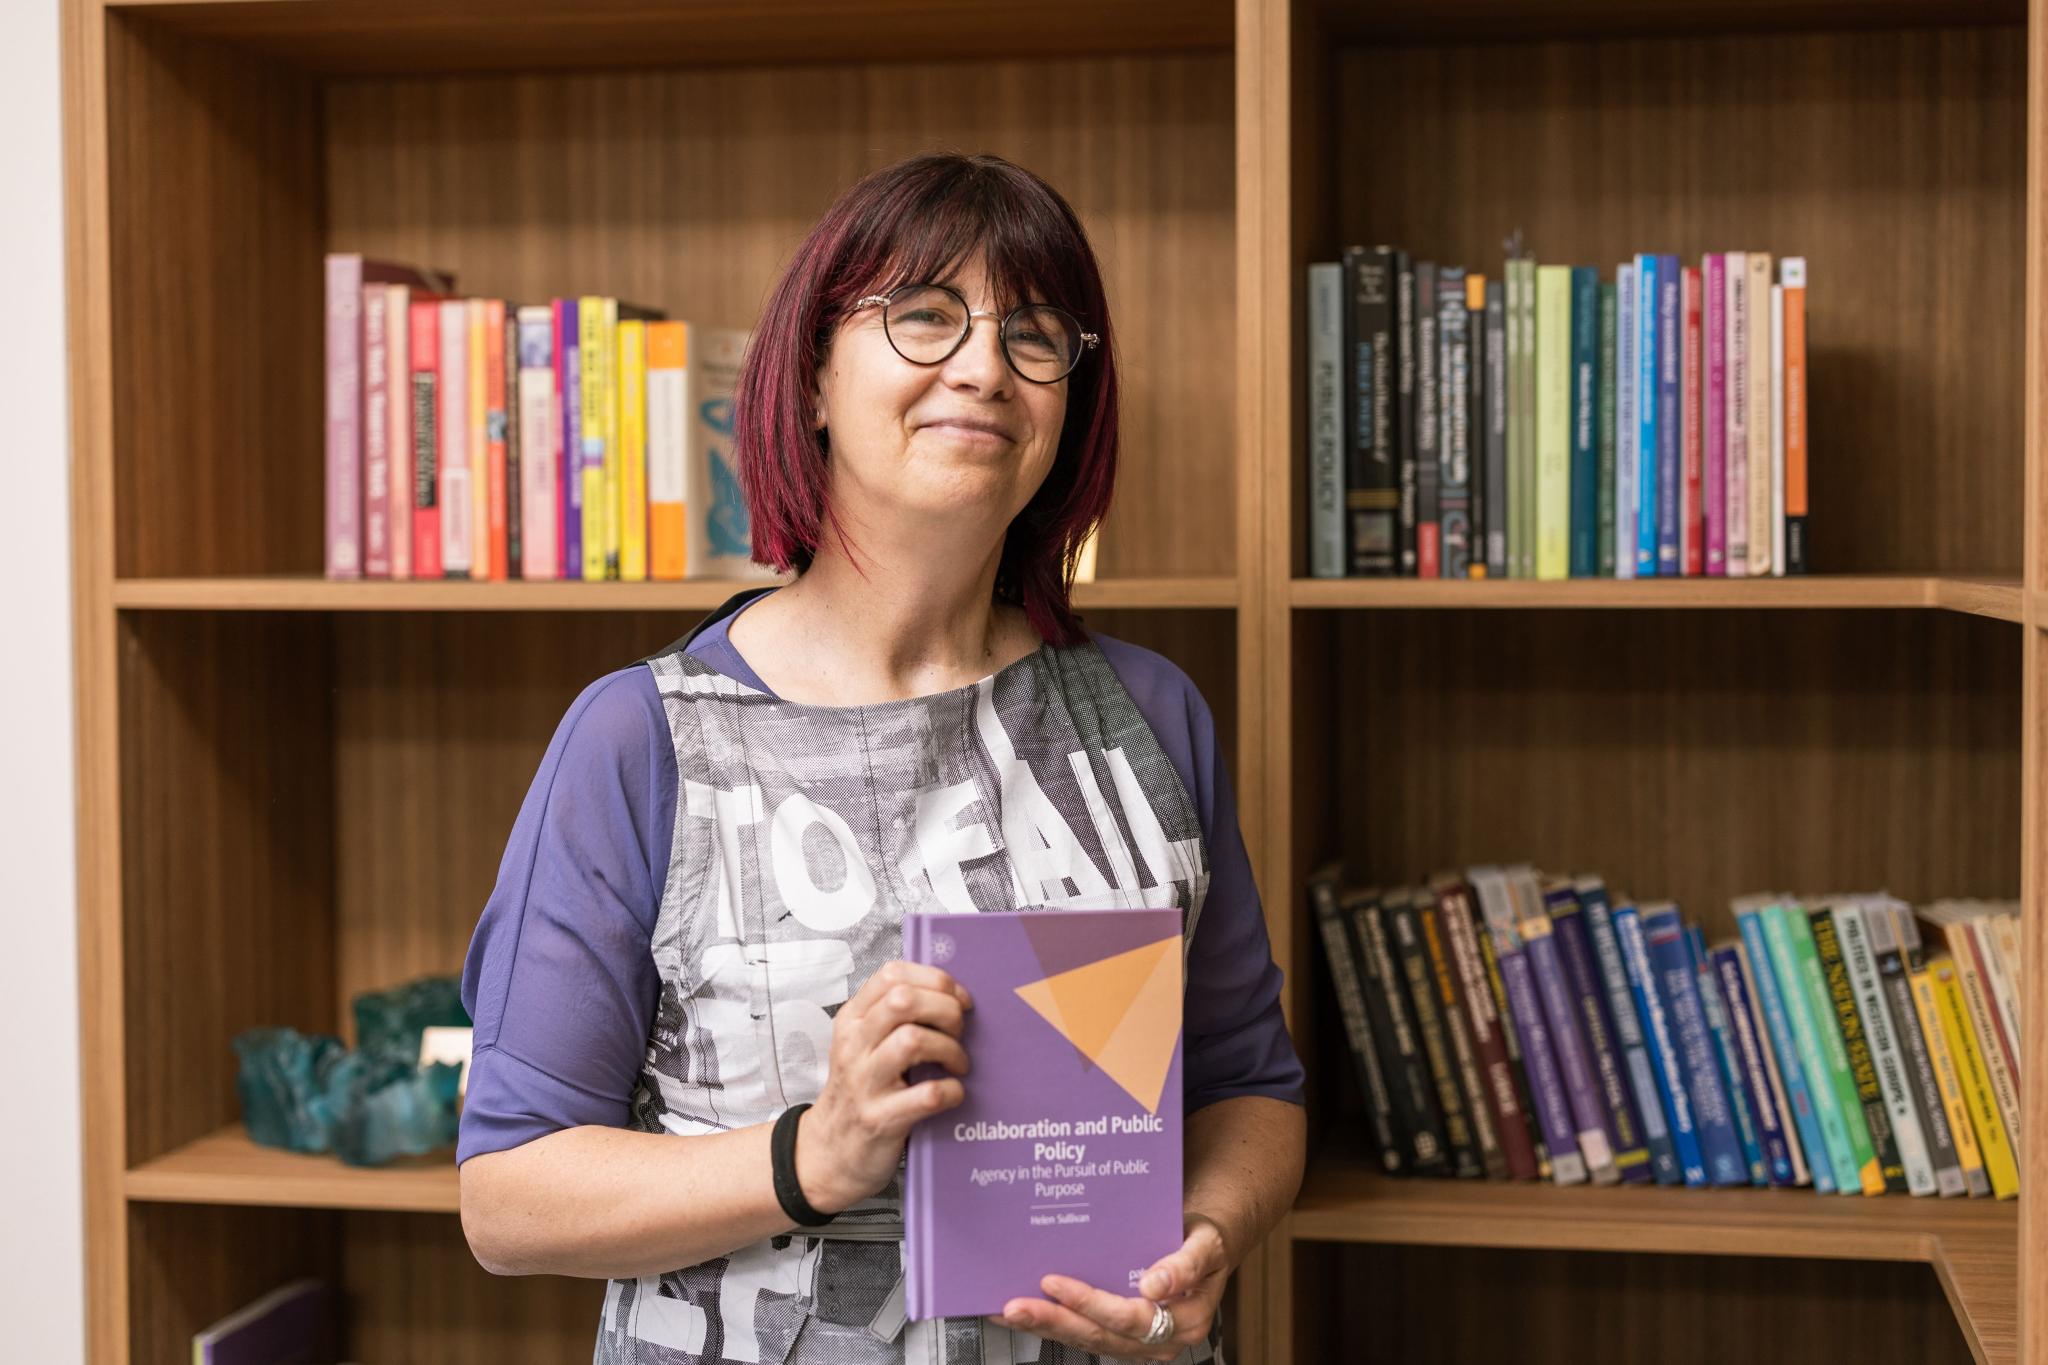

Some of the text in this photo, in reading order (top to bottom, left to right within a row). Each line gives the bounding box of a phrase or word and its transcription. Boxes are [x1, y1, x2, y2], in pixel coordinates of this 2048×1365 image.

[1317, 360, 1335, 512] PUBLIC POLICY
[685, 747, 1203, 937] TO FAIL
[1842, 915, 1871, 976] POLITICS
[1859, 975, 1876, 992] IN
[1813, 916, 1879, 1101] THE NATION STATE
[1864, 993, 1893, 1053] WESTERN
[1879, 1053, 1907, 1106] EUROPE
[954, 1115, 1163, 1142] Collaboration and Public
[1034, 1141, 1086, 1164] Policy
[970, 1159, 1150, 1187] Agency in the Pursuit of Public
[1035, 1182, 1085, 1199] Purpose
[1030, 1213, 1090, 1226] Helen Sullivan
